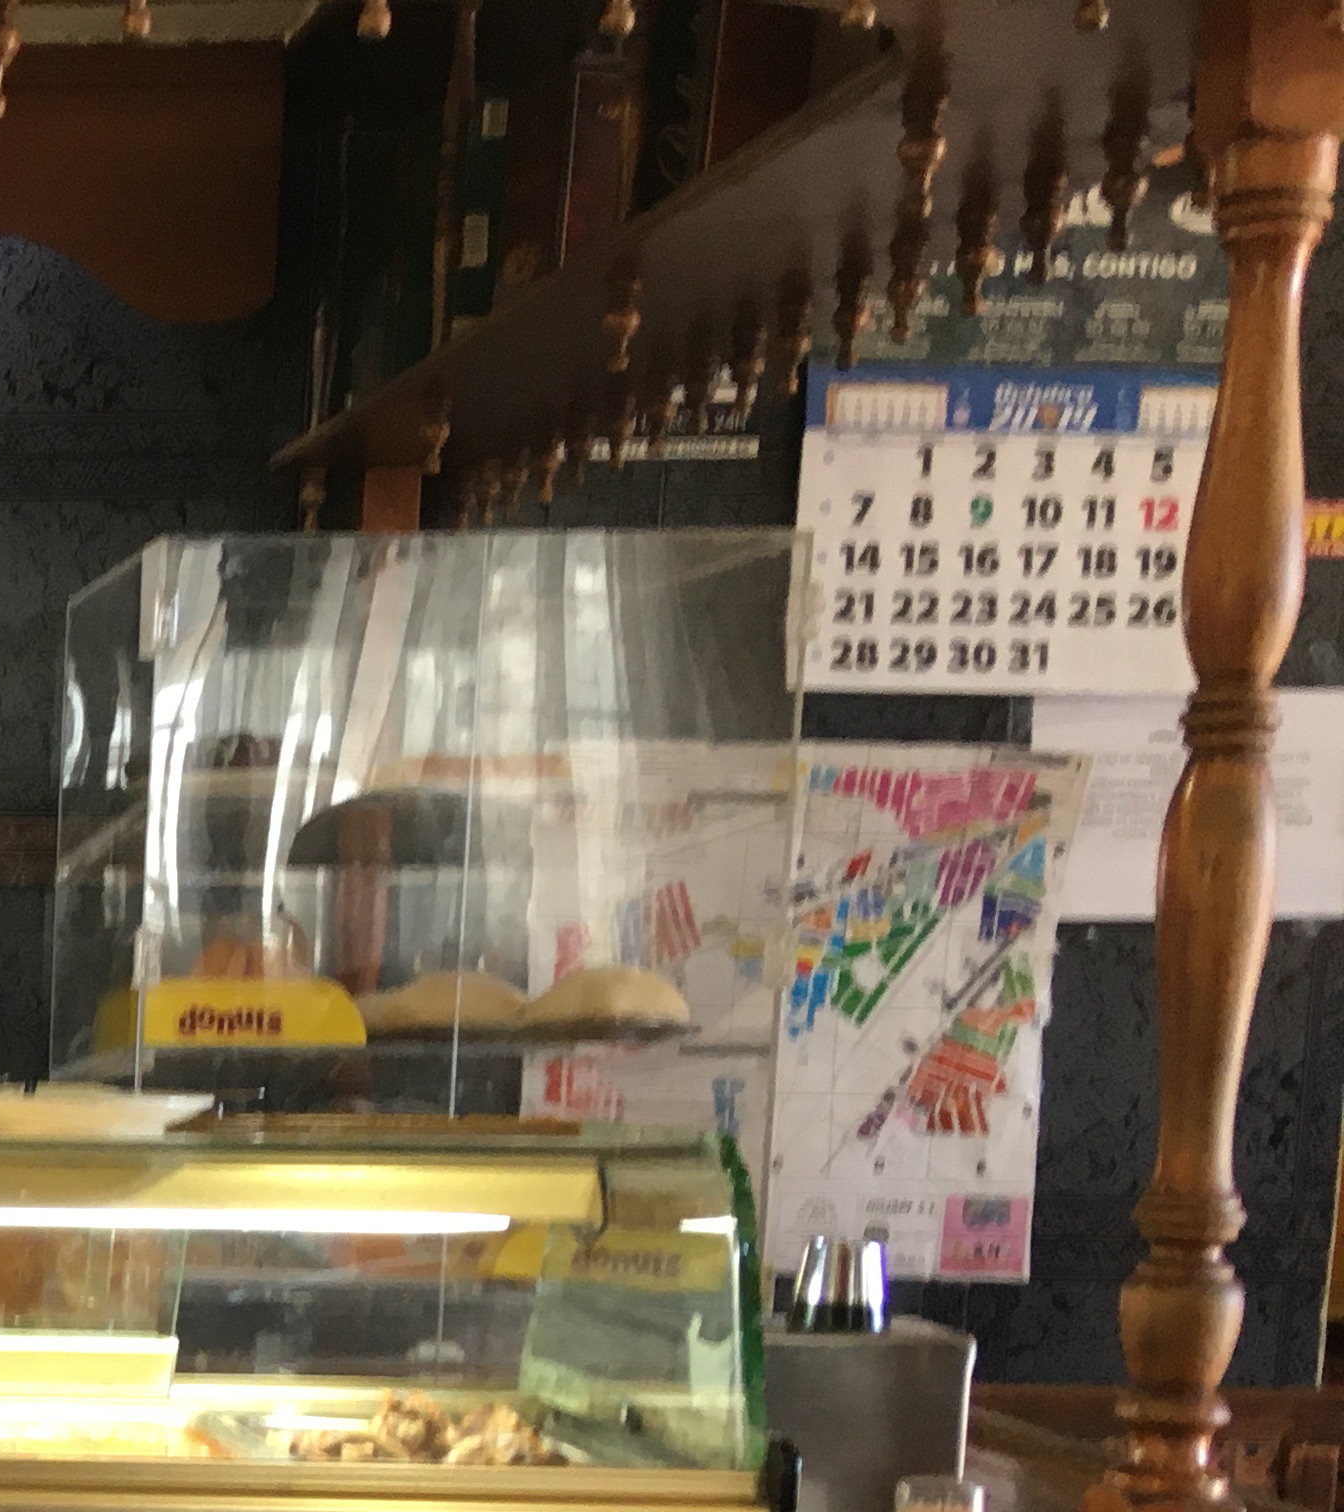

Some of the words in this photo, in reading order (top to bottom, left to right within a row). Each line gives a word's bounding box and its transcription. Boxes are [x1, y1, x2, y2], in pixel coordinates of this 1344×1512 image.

[916, 444, 934, 480] 1
[972, 444, 997, 480] 2
[1031, 446, 1056, 482] 3
[1090, 446, 1116, 483] 4
[1150, 447, 1175, 483] 5
[851, 490, 876, 526] 7
[910, 491, 935, 528] 8
[969, 494, 994, 529] 9
[1022, 494, 1064, 530] 10
[1081, 495, 1117, 531] 11
[1139, 496, 1179, 531] 12
[839, 540, 881, 576] 14
[899, 541, 940, 577] 15
[958, 542, 1000, 578] 16
[1018, 543, 1059, 578] 17
[1077, 544, 1119, 579] 18
[1136, 546, 1178, 580] 19
[832, 590, 874, 625] 21
[891, 590, 940, 626] 22
[950, 591, 998, 627] 23
[1009, 592, 1058, 628] 24
[1068, 593, 1117, 629] 25
[1127, 594, 1177, 630] 26
[830, 637, 880, 672] 28
[889, 638, 938, 673] 29
[948, 639, 998, 674] 30
[1008, 640, 1050, 675] 31
[178, 1003, 284, 1037] donuts
